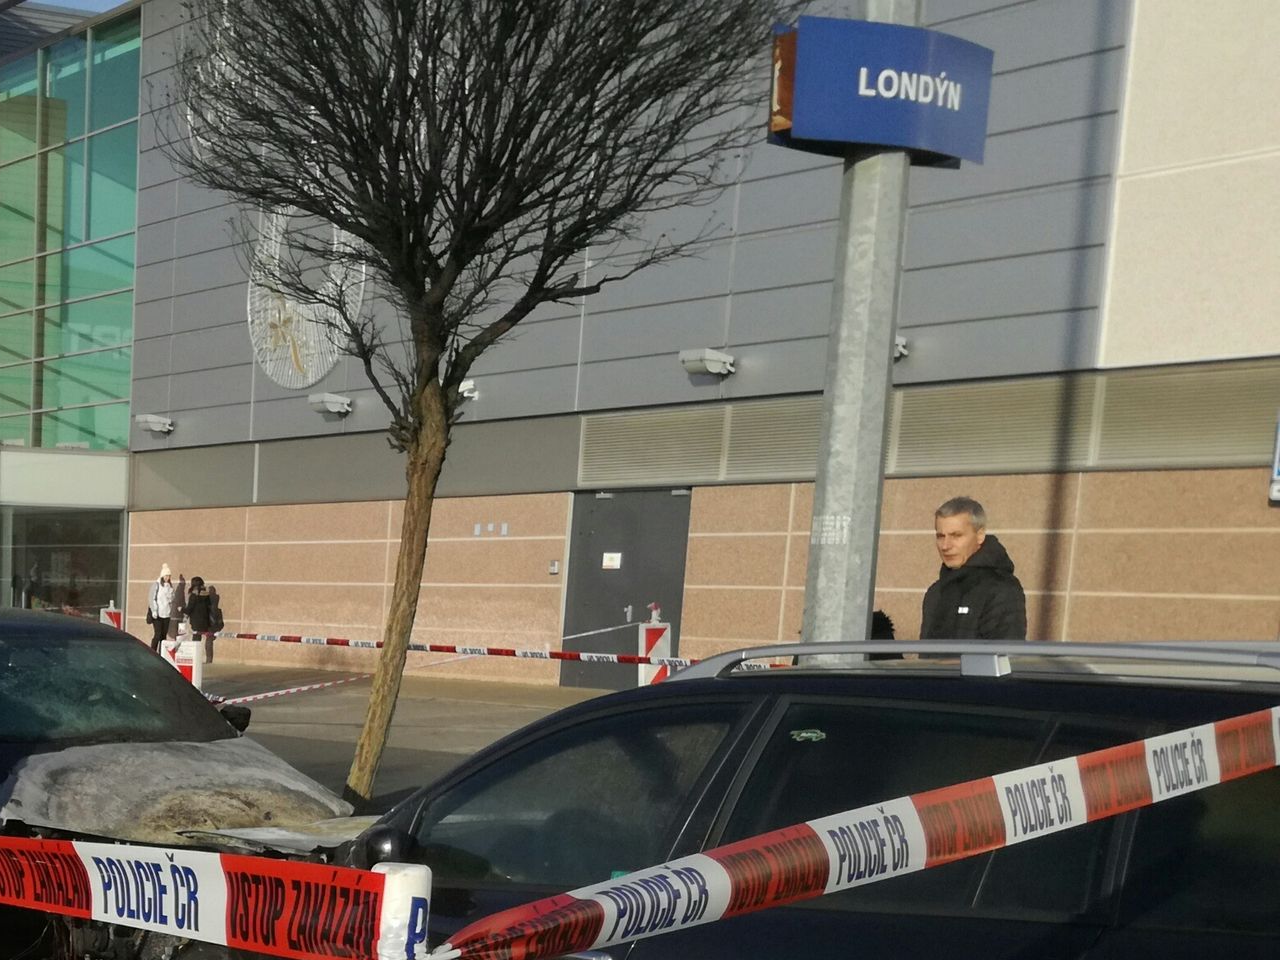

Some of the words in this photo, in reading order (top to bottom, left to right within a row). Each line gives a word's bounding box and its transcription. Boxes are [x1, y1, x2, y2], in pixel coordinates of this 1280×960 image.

[858, 67, 961, 111] LONDÝN
[1152, 741, 1193, 795] POLICIE
[1190, 731, 1208, 784] ČR
[1005, 778, 1054, 837] POLICIE
[1047, 766, 1072, 825] ČR
[827, 818, 888, 885] POLICIE
[877, 806, 909, 870] ČR
[92, 856, 168, 926] POLICIE
[165, 852, 199, 932] ČR
[227, 871, 285, 947] VSTUP
[287, 871, 379, 960] ZAKÁZÁN
[596, 874, 681, 942] POLICIE
[663, 865, 709, 925] ČR
